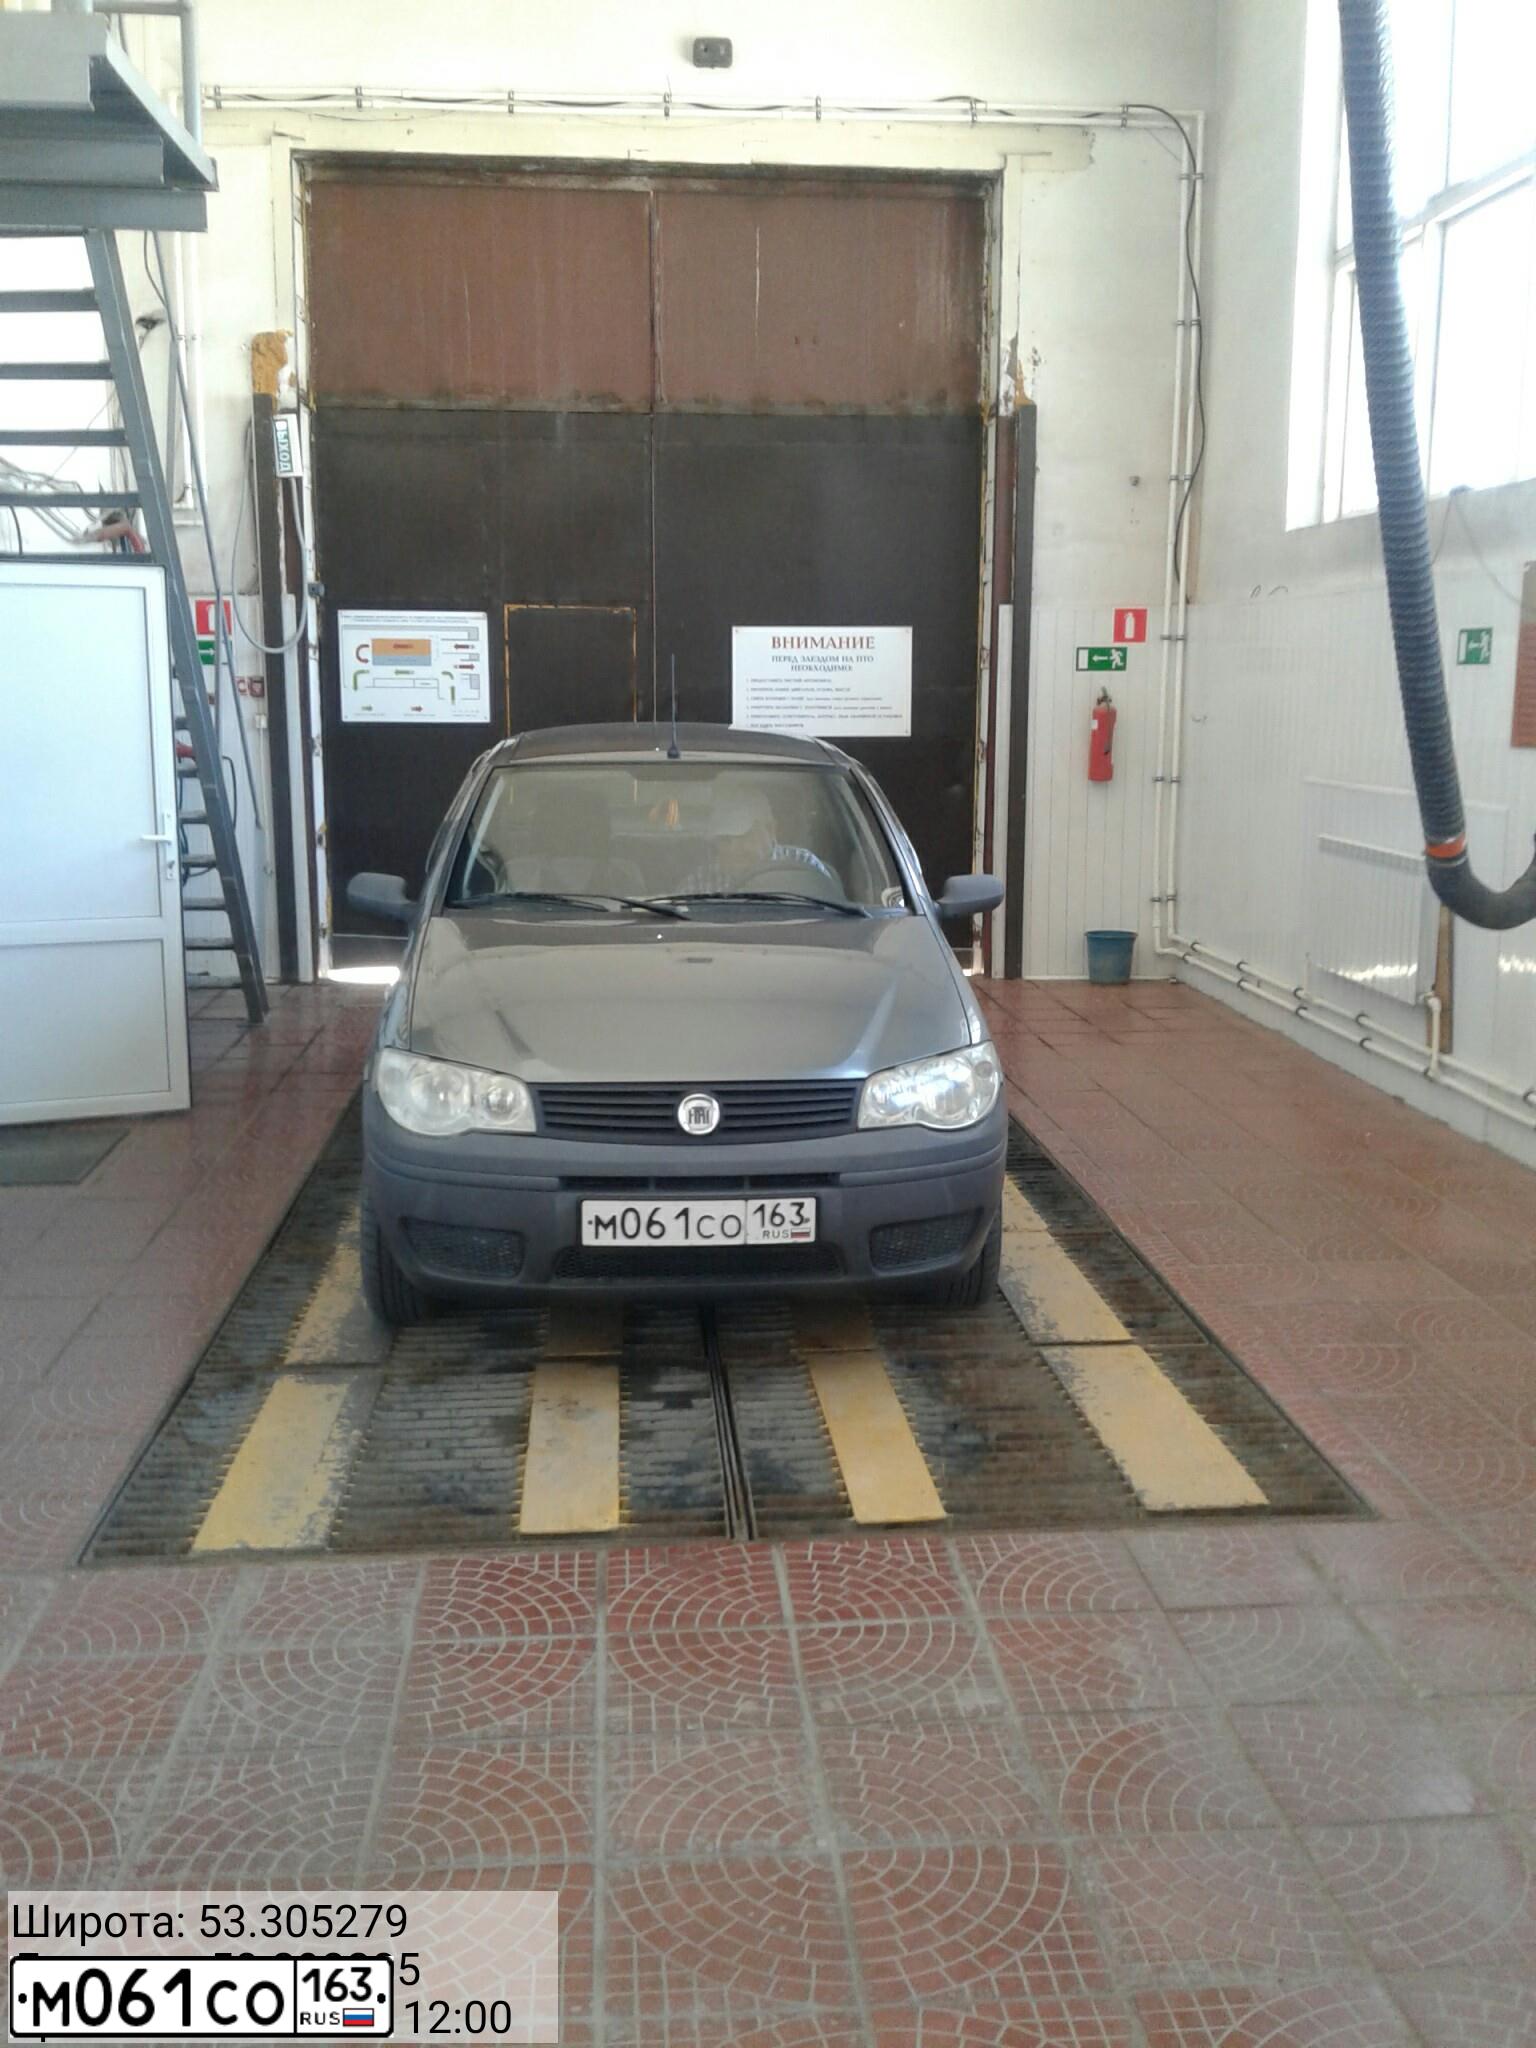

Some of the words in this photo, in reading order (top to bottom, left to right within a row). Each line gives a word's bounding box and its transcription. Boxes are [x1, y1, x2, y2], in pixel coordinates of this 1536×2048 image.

[275, 420, 292, 472] ВЫХОД
[771, 635, 876, 650] ВНИМАНИЕ
[771, 655, 799, 664] ПЕРЕД
[800, 655, 840, 664] ЗАЕЗДОМ
[842, 655, 854, 663] НА
[856, 655, 875, 663] ПТО
[753, 1202, 805, 1228] 163
[762, 1229, 790, 1239] RUS
